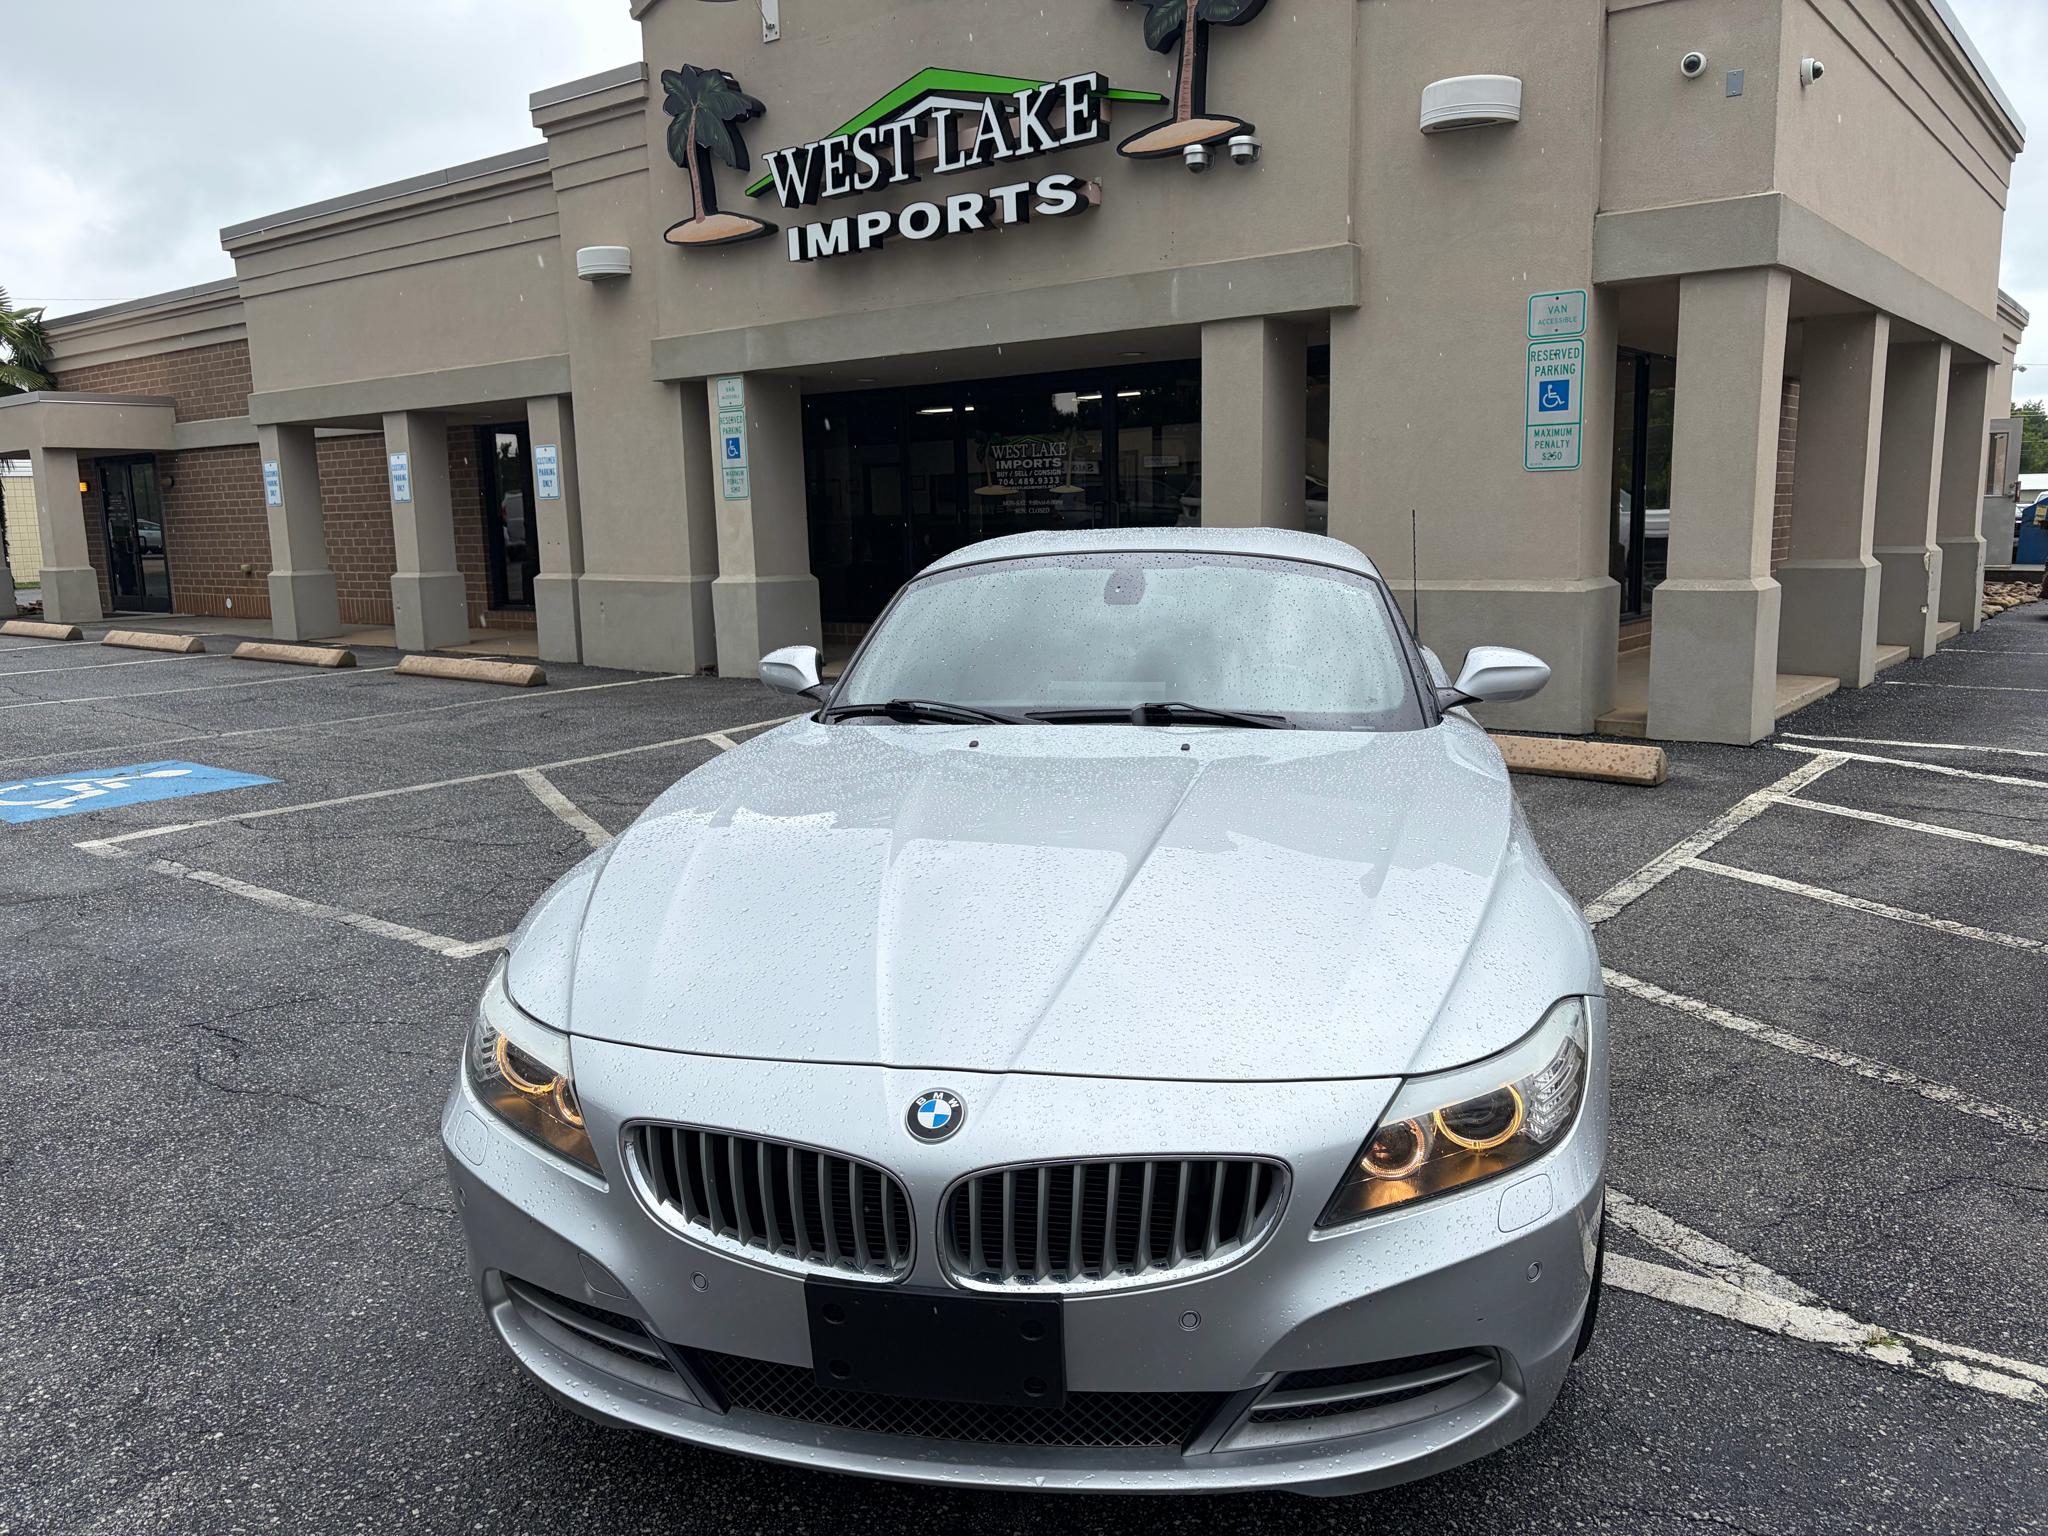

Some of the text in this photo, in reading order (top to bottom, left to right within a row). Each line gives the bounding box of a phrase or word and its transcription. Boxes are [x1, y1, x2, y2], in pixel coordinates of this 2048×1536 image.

[786, 173, 1078, 263] IMPORTS
[1547, 304, 1568, 315] VAN
[1537, 316, 1578, 326] ACCESSIBLE
[1530, 346, 1580, 362] RESERVED
[1534, 363, 1576, 377] PARKING
[722, 426, 742, 435] PARKING
[1533, 427, 1573, 438] MAXIMUM
[1534, 439, 1570, 449] PENALTY
[991, 441, 1067, 459] WEST LAKE
[536, 456, 556, 464] CUSTOMER
[1541, 451, 1563, 461] $250
[995, 458, 1062, 470] IMPORTS
[538, 468, 556, 476] PARKING
[915, 1092, 959, 1108] BMW
